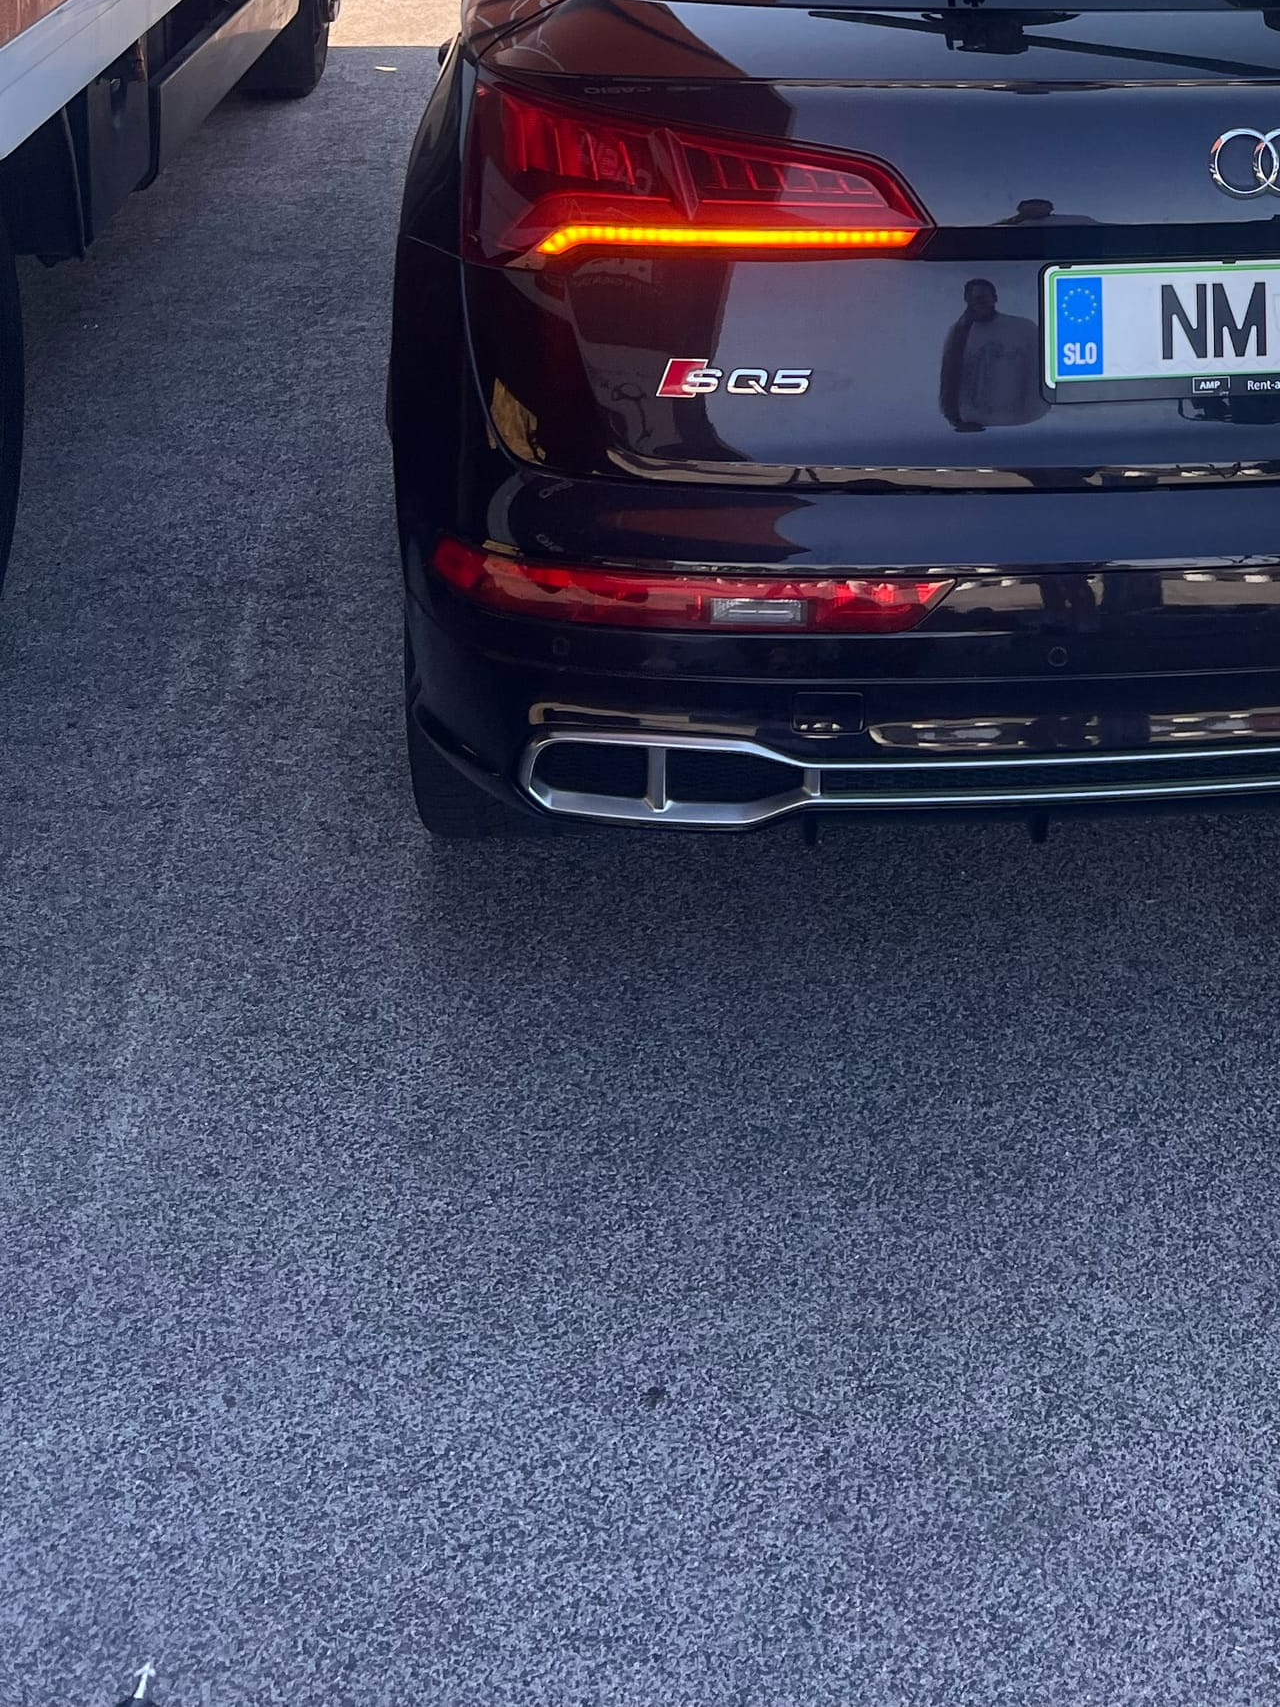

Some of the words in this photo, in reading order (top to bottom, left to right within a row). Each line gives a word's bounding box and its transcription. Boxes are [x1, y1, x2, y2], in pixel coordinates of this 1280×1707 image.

[1161, 281, 1267, 360] NM
[1063, 343, 1097, 366] SLO
[681, 367, 813, 396] SQ5
[1199, 380, 1221, 390] AMP
